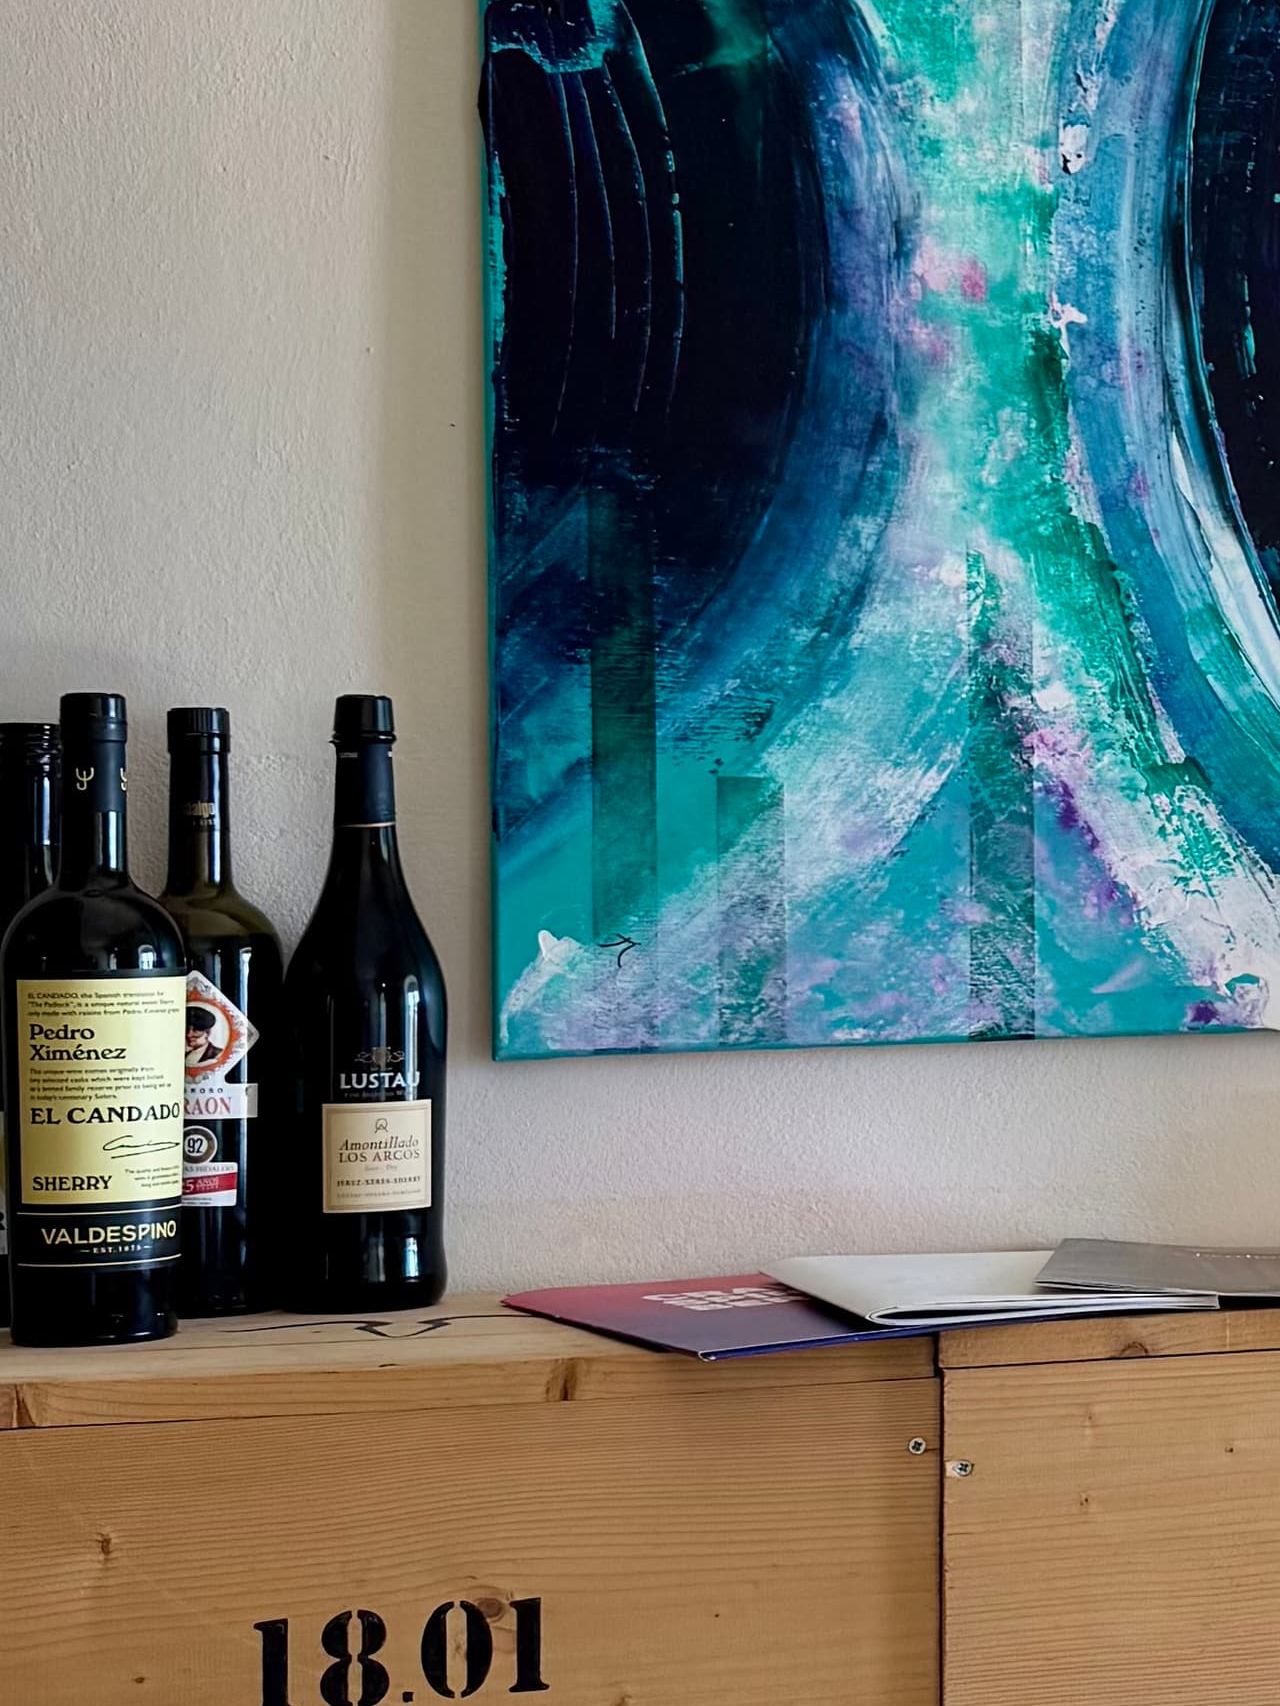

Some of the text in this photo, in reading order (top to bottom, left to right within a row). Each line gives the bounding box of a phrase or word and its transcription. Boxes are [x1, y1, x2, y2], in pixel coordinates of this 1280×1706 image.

[30, 1024, 95, 1040] Pedro
[30, 1044, 126, 1061] Ximénez
[340, 1071, 420, 1089] LUSTAU
[31, 1102, 180, 1125] EL CANDADO
[184, 1096, 231, 1116] RAON
[187, 1137, 205, 1154] 92
[339, 1135, 419, 1151] Amontillado
[339, 1149, 420, 1164] LOS ARCOS
[32, 1175, 112, 1191] SHERRY
[41, 1220, 177, 1245] VALDESPINO
